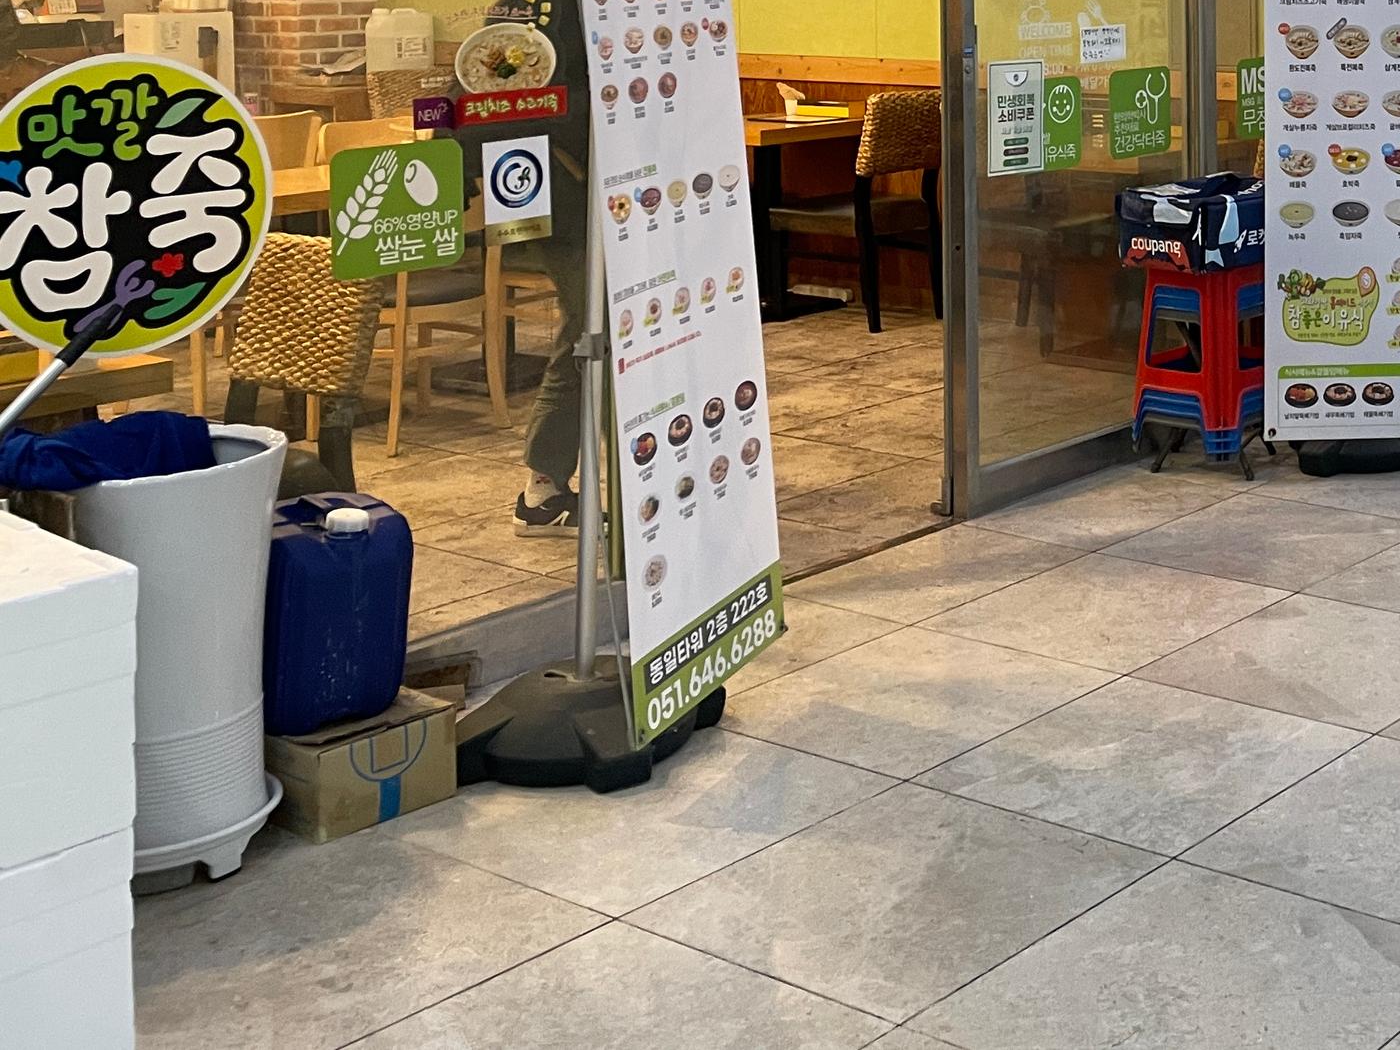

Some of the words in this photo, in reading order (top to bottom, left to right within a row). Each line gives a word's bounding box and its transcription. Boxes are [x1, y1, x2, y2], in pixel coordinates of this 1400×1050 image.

[417, 108, 441, 122] NEW
[997, 93, 1036, 109] 민생회복
[997, 107, 1036, 123] 소비쿠폰
[27, 82, 158, 161] 맛깔
[1114, 129, 1166, 154] 건강닥터죽
[0, 126, 248, 314] 참죽
[374, 234, 427, 266] 쌀눈
[432, 226, 459, 257] 쌀
[1131, 236, 1182, 258] coupang
[650, 627, 704, 684] 동일타워
[707, 610, 728, 642] 2층
[731, 581, 769, 624] 222호
[647, 609, 777, 730] 051.646.6288
